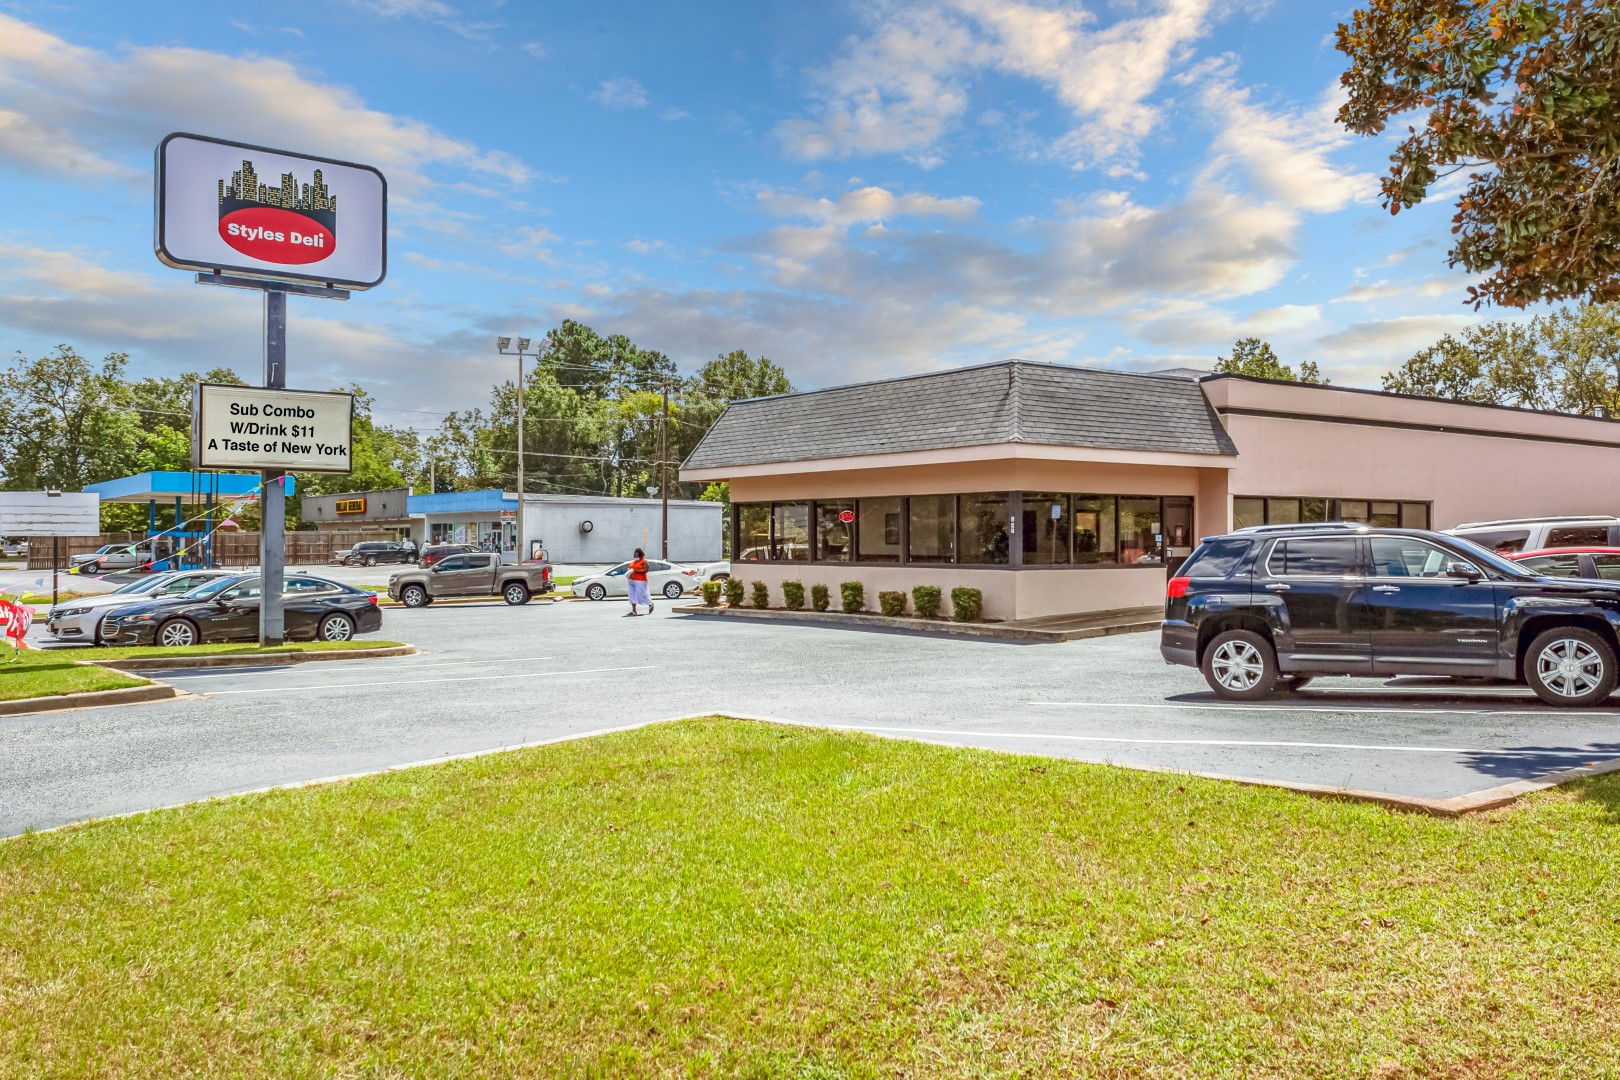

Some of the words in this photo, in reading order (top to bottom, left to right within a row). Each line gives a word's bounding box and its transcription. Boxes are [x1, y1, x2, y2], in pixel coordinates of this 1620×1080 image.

[227, 222, 285, 244] Styles
[290, 231, 324, 248] Deli
[229, 402, 259, 417] Sub
[262, 403, 315, 419] Combo
[230, 421, 287, 437] W/Drink
[291, 424, 315, 438] $11
[207, 438, 218, 451] A
[221, 438, 260, 453] Taste
[263, 441, 278, 453] of
[281, 441, 312, 455] New
[315, 443, 347, 456] York
